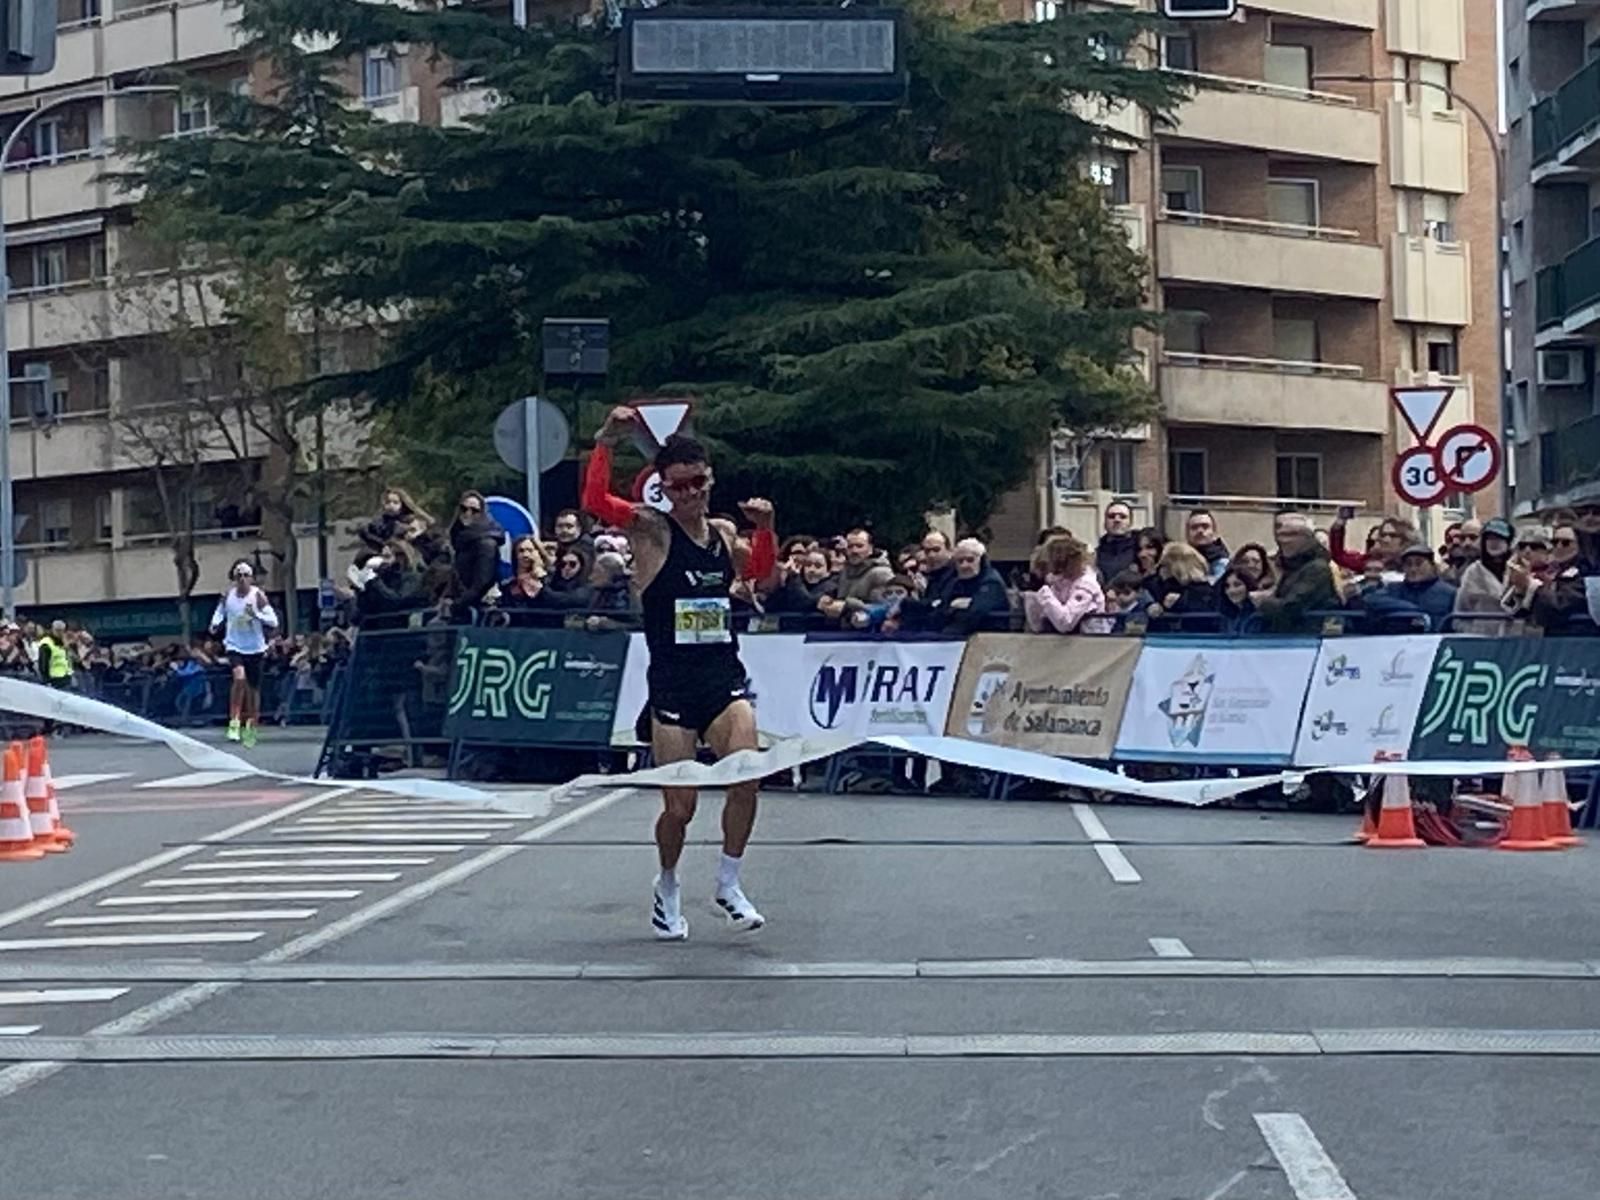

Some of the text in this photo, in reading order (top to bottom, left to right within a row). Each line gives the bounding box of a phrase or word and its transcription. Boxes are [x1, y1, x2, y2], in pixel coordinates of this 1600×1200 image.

[1406, 467, 1438, 486] 30
[649, 483, 664, 503] 3
[448, 642, 557, 720] JRG
[1419, 650, 1548, 746] JRG
[1023, 711, 1102, 736] Salamanca
